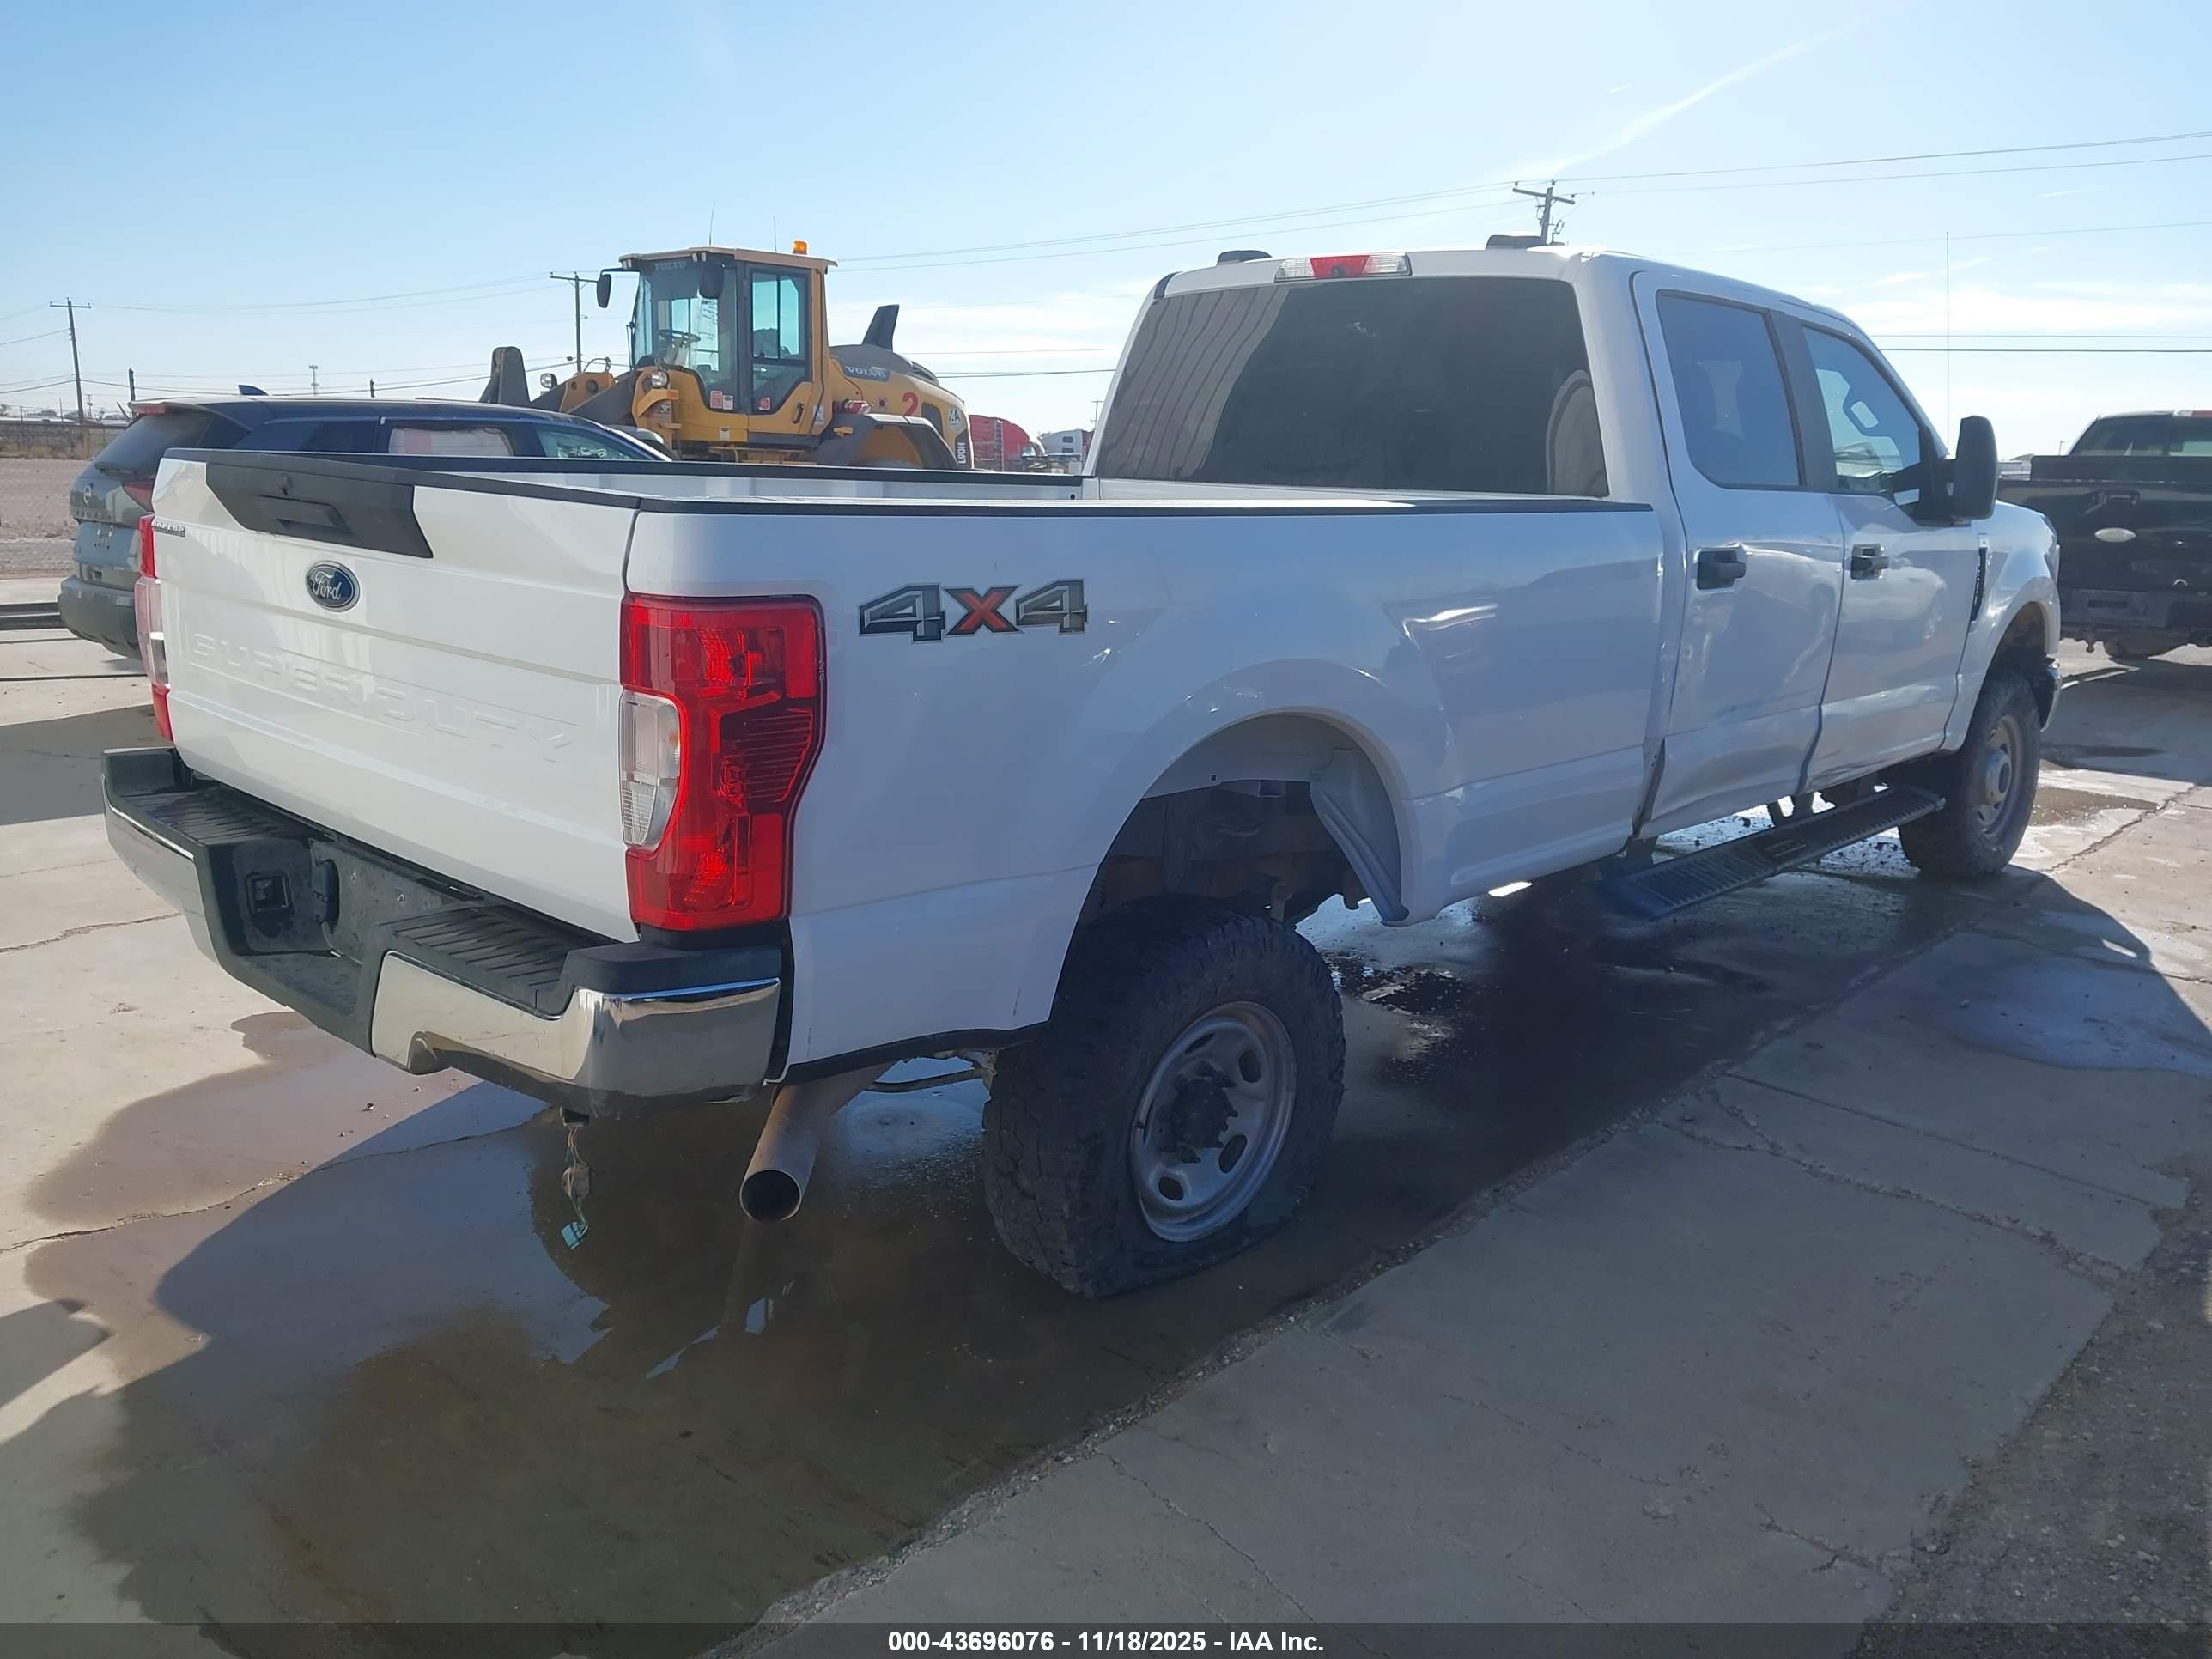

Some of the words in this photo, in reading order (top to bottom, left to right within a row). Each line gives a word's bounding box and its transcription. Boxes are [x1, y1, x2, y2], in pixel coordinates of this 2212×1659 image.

[845, 365, 886, 379] VOLVO
[902, 392, 919, 416] 2
[957, 442, 967, 465] L90H
[313, 571, 343, 600] Ford
[191, 631, 372, 709] SUPER
[375, 686, 575, 764] DUTY
